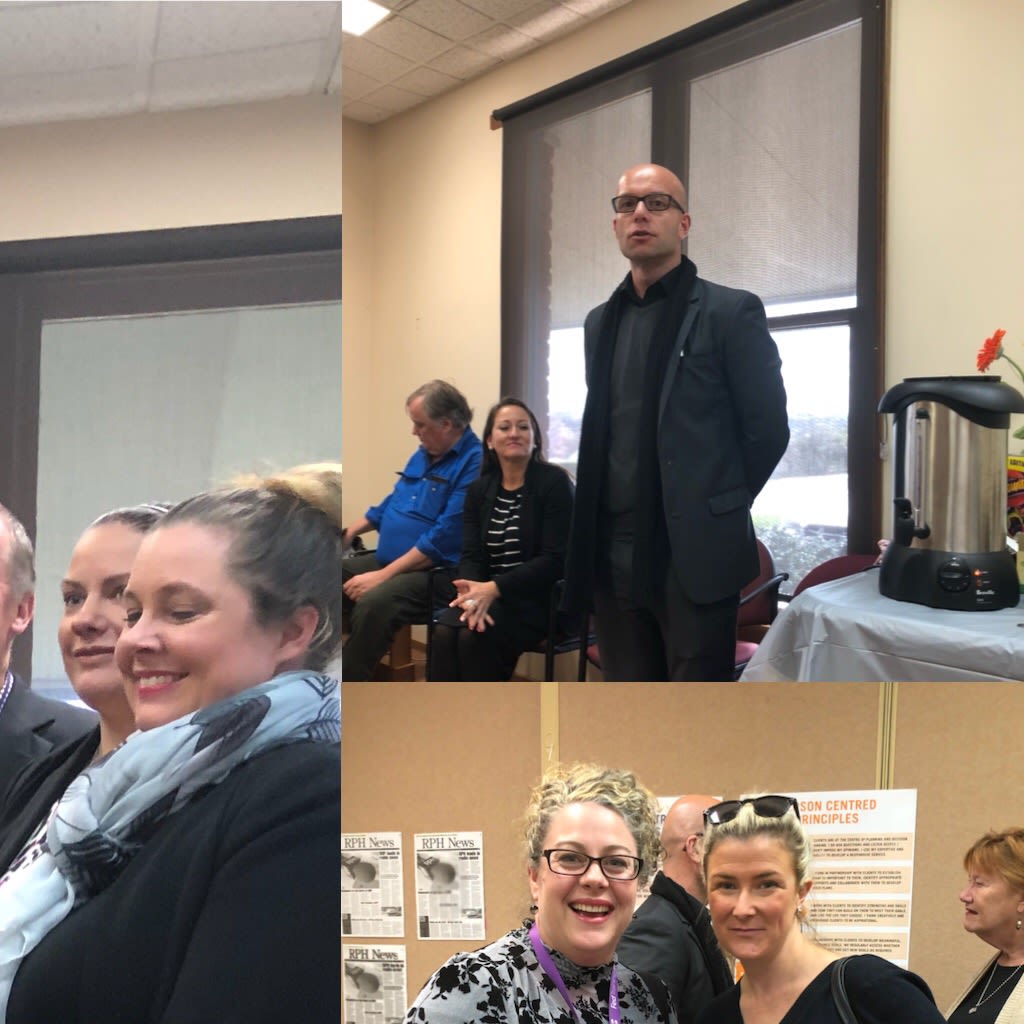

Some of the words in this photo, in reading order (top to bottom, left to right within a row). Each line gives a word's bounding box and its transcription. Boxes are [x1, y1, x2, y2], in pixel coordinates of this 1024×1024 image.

[800, 800, 822, 812] SON
[826, 799, 877, 811] CENTRED
[801, 813, 859, 824] RINCIPLES
[344, 838, 366, 848] RPH
[369, 838, 395, 848] News
[422, 838, 444, 849] RPH
[448, 838, 475, 848] News
[349, 948, 369, 960] RPH
[372, 948, 398, 960] News
